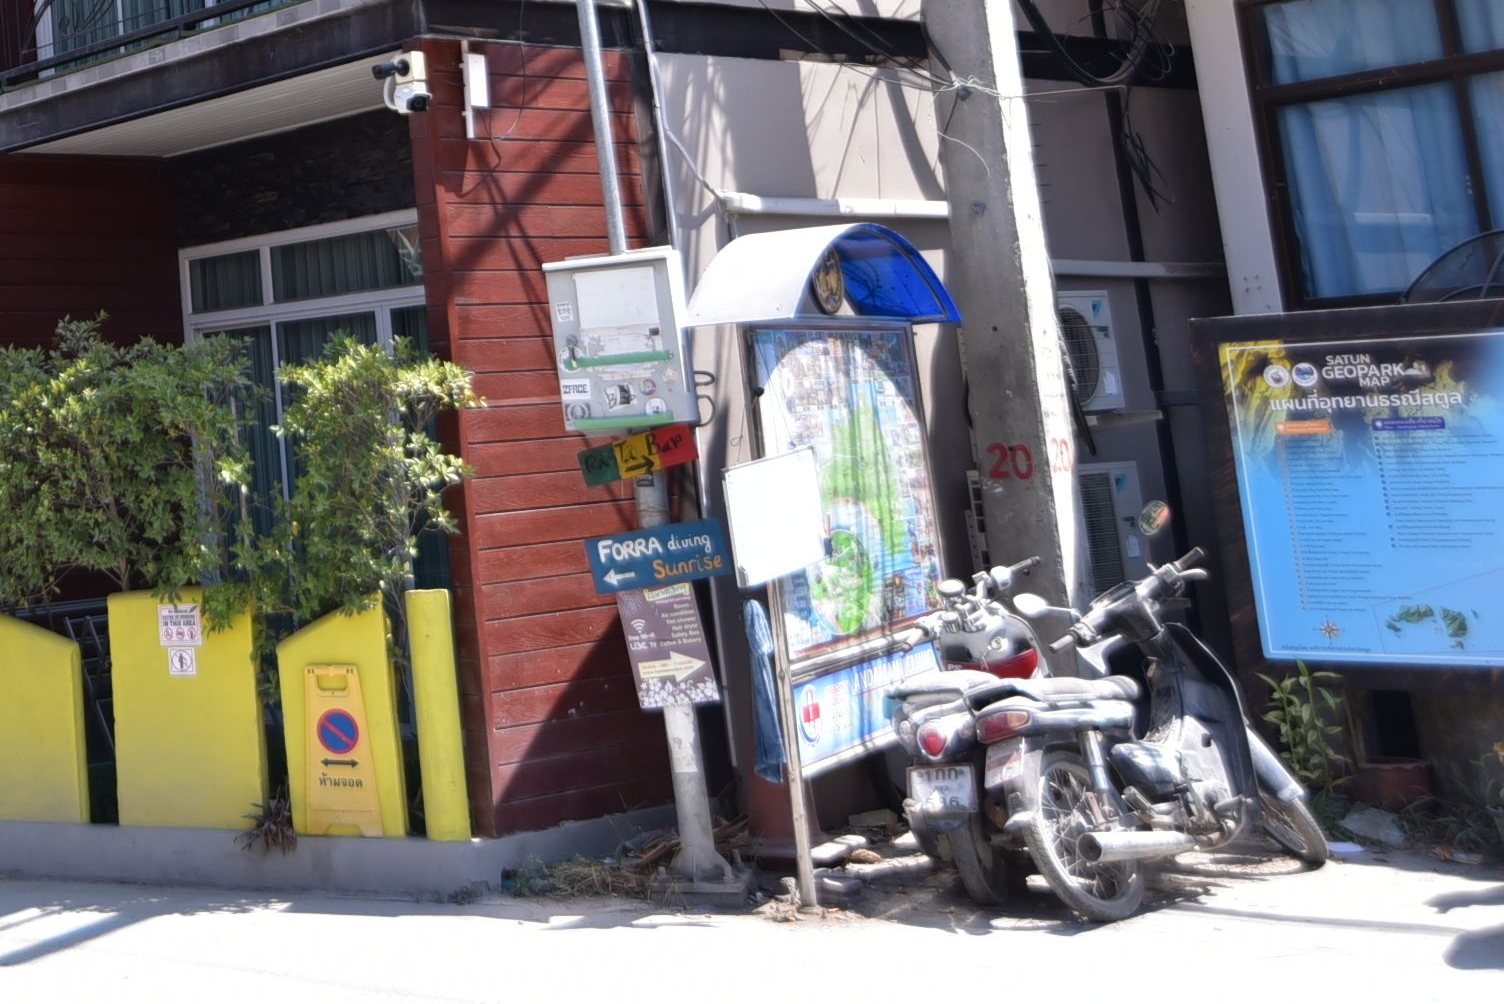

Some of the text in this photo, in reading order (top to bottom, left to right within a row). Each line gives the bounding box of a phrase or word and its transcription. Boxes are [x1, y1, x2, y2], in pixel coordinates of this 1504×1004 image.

[1321, 362, 1405, 379] GEOPARK
[1325, 353, 1370, 365] SATUN
[1359, 376, 1390, 387] MAP
[1270, 389, 1462, 414] แผนที่อุทยานธรณีสตูล
[986, 442, 1033, 480] 20
[1050, 437, 1072, 473] 20
[598, 534, 711, 563] FORRA diving
[653, 554, 722, 579] Sunrise
[319, 772, 363, 788] ห้ามจอด
